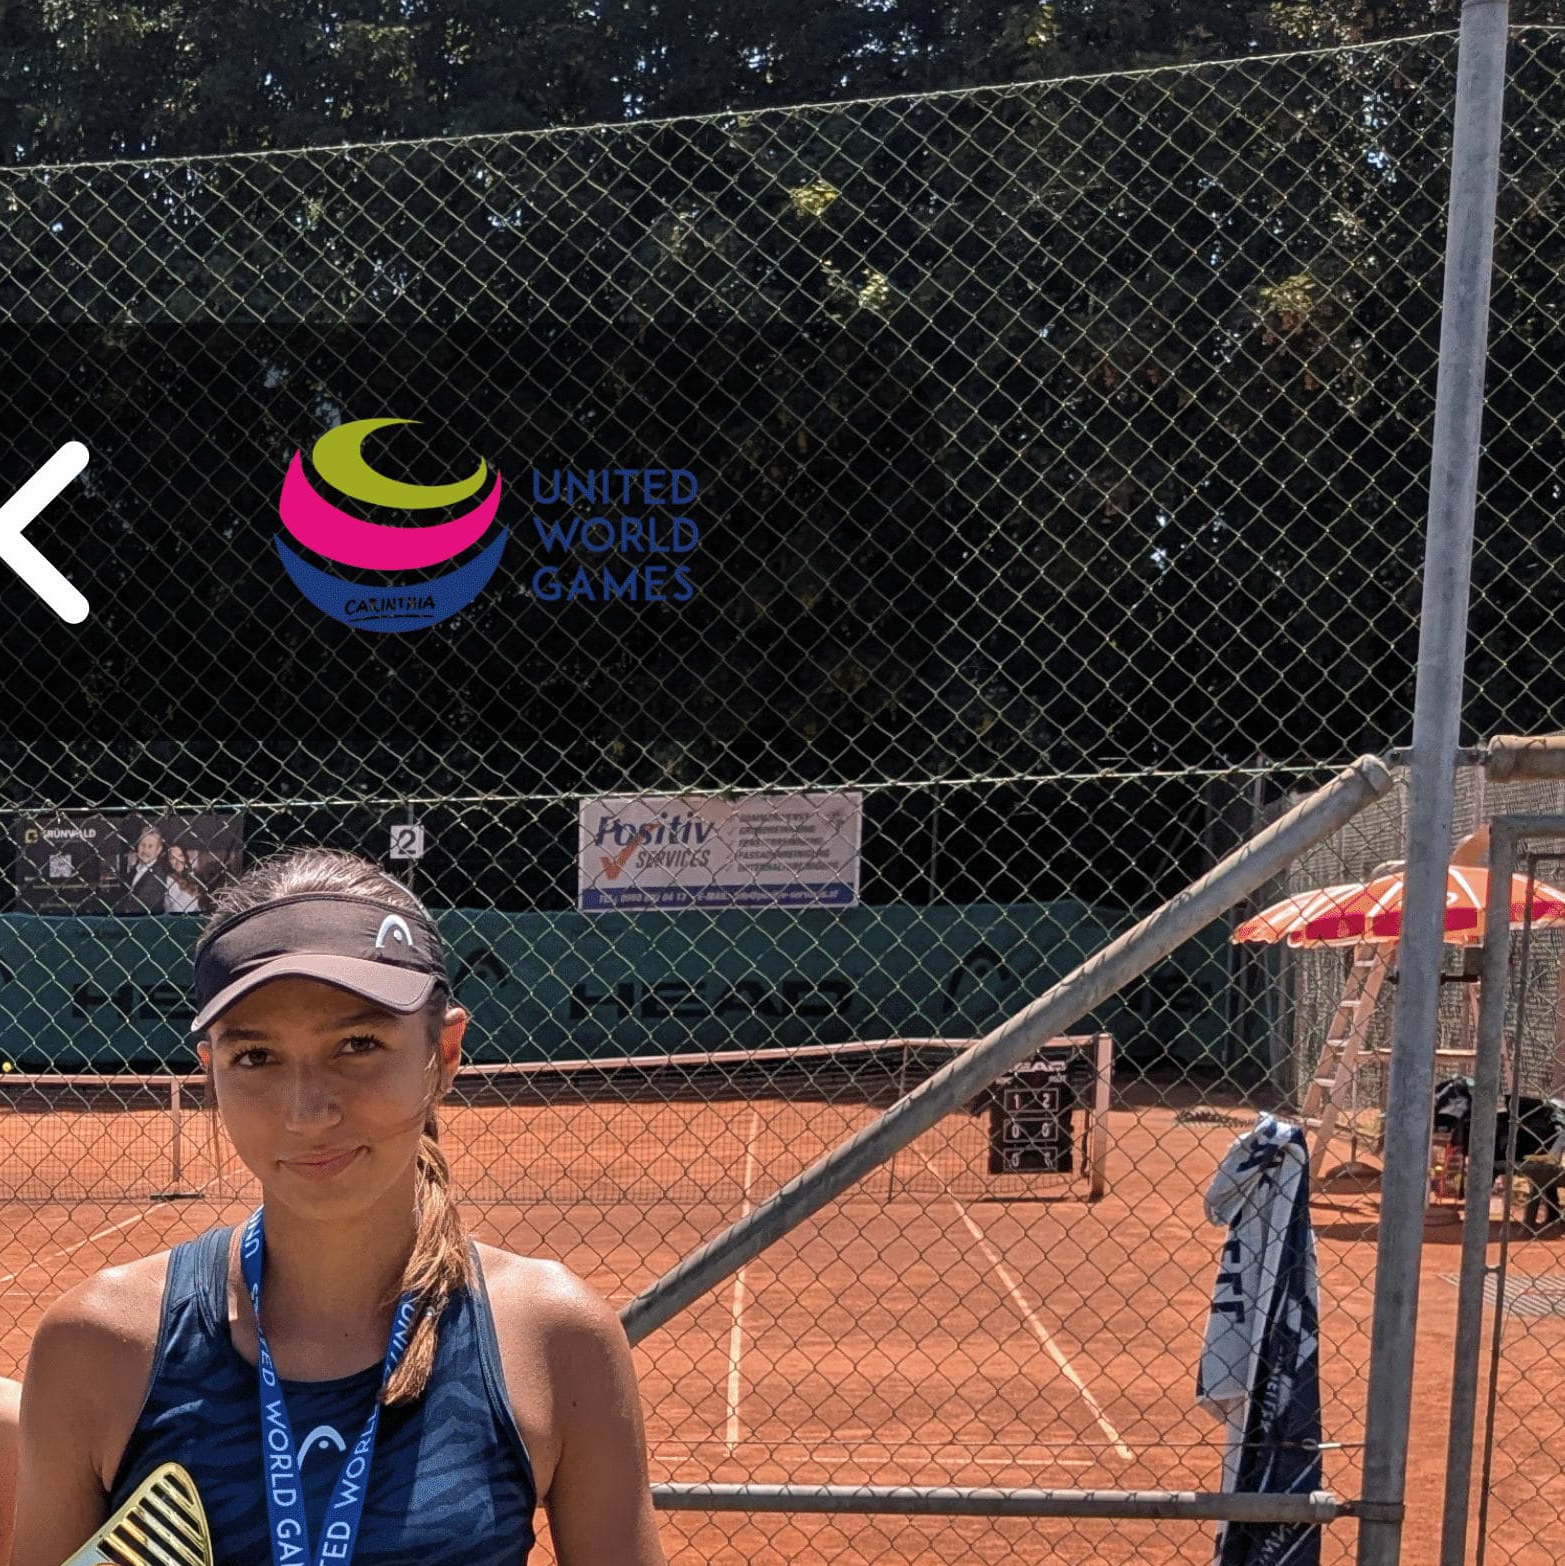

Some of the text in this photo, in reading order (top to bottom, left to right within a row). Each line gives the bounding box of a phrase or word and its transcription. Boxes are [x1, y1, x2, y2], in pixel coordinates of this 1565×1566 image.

[398, 829, 416, 855] 2
[595, 811, 715, 847] Positiv
[636, 850, 711, 869] SERVICES
[570, 980, 852, 1019] HEAD
[265, 1400, 297, 1507] WORLD
